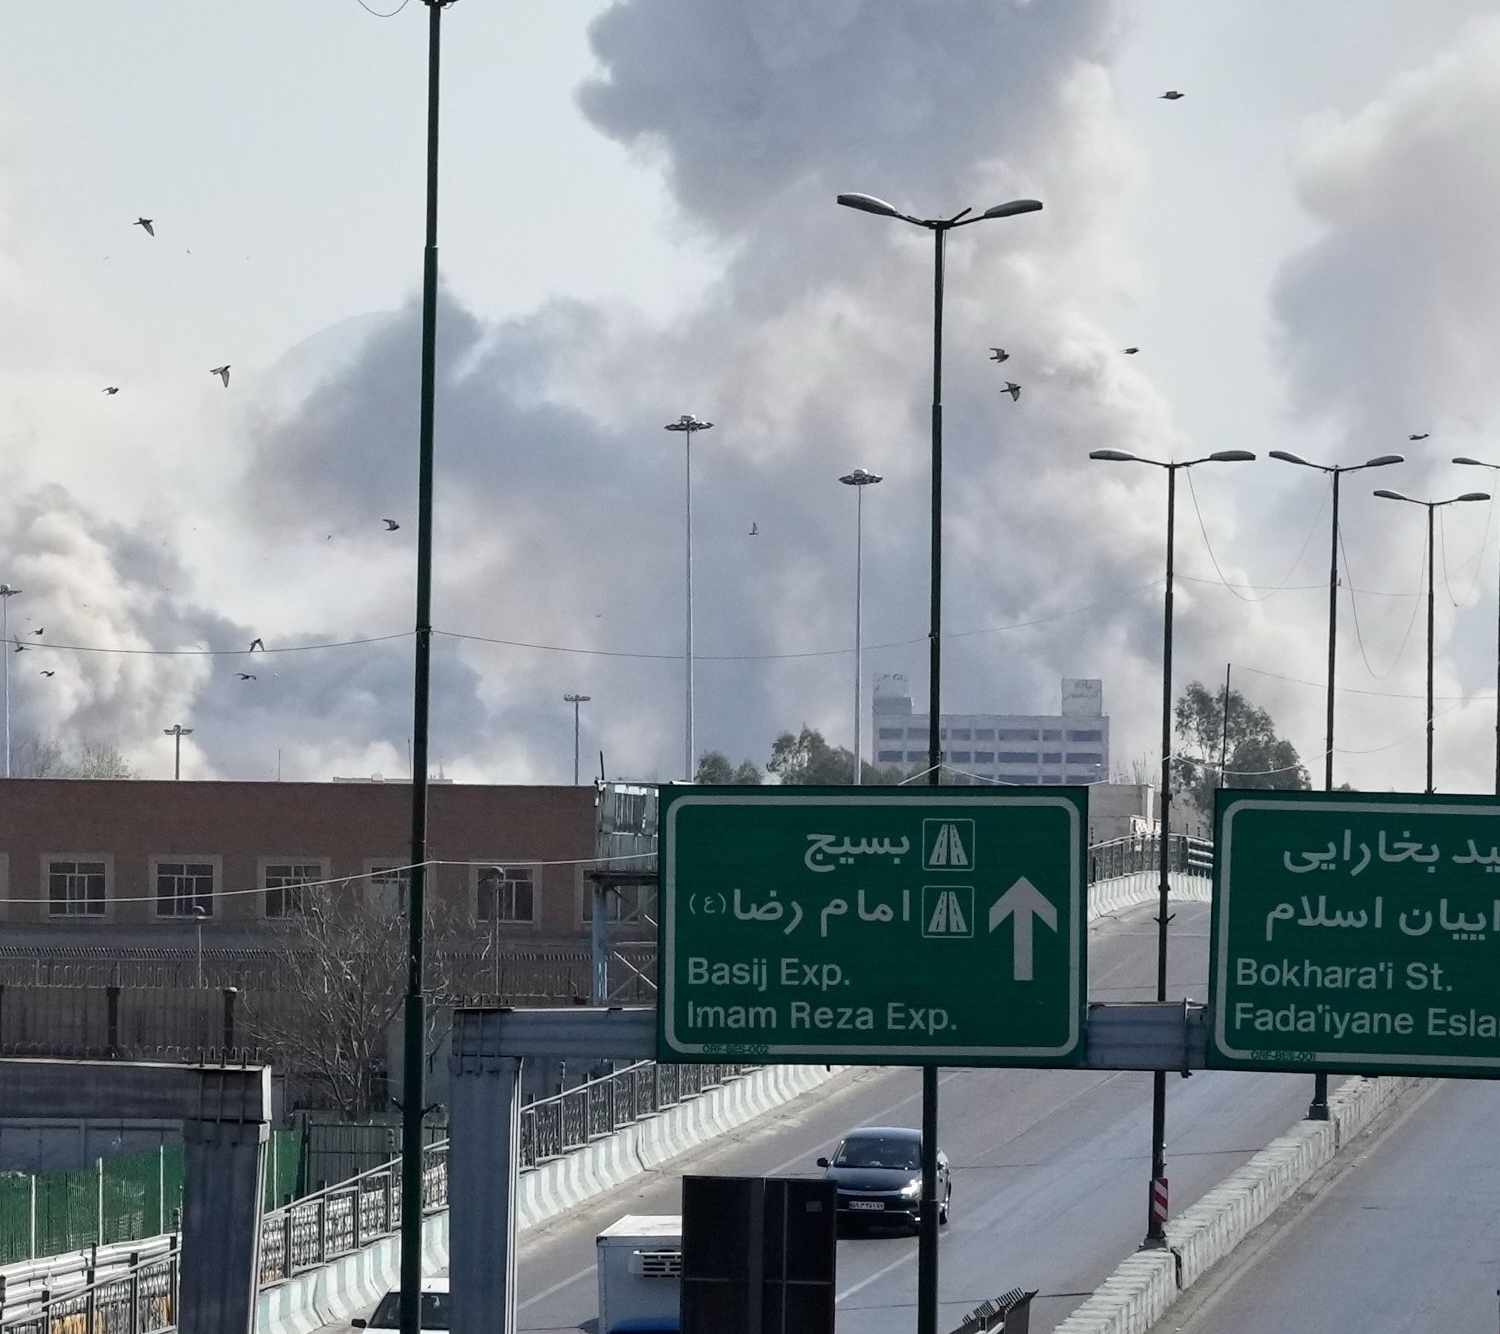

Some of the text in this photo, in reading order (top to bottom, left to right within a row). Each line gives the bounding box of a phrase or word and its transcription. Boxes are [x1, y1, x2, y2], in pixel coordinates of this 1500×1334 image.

[805, 834, 909, 872] بسیج
[1284, 830, 1439, 876] بخارایی
[734, 889, 803, 934] رضا
[821, 890, 909, 937] امام
[1266, 896, 1382, 941] اسلام
[689, 957, 849, 991] Basij Exp.
[1237, 958, 1452, 991] Bokhara'i St.
[688, 1001, 956, 1035] Imam Reza Exp.
[1236, 1003, 1413, 1038] Fada'iyane
